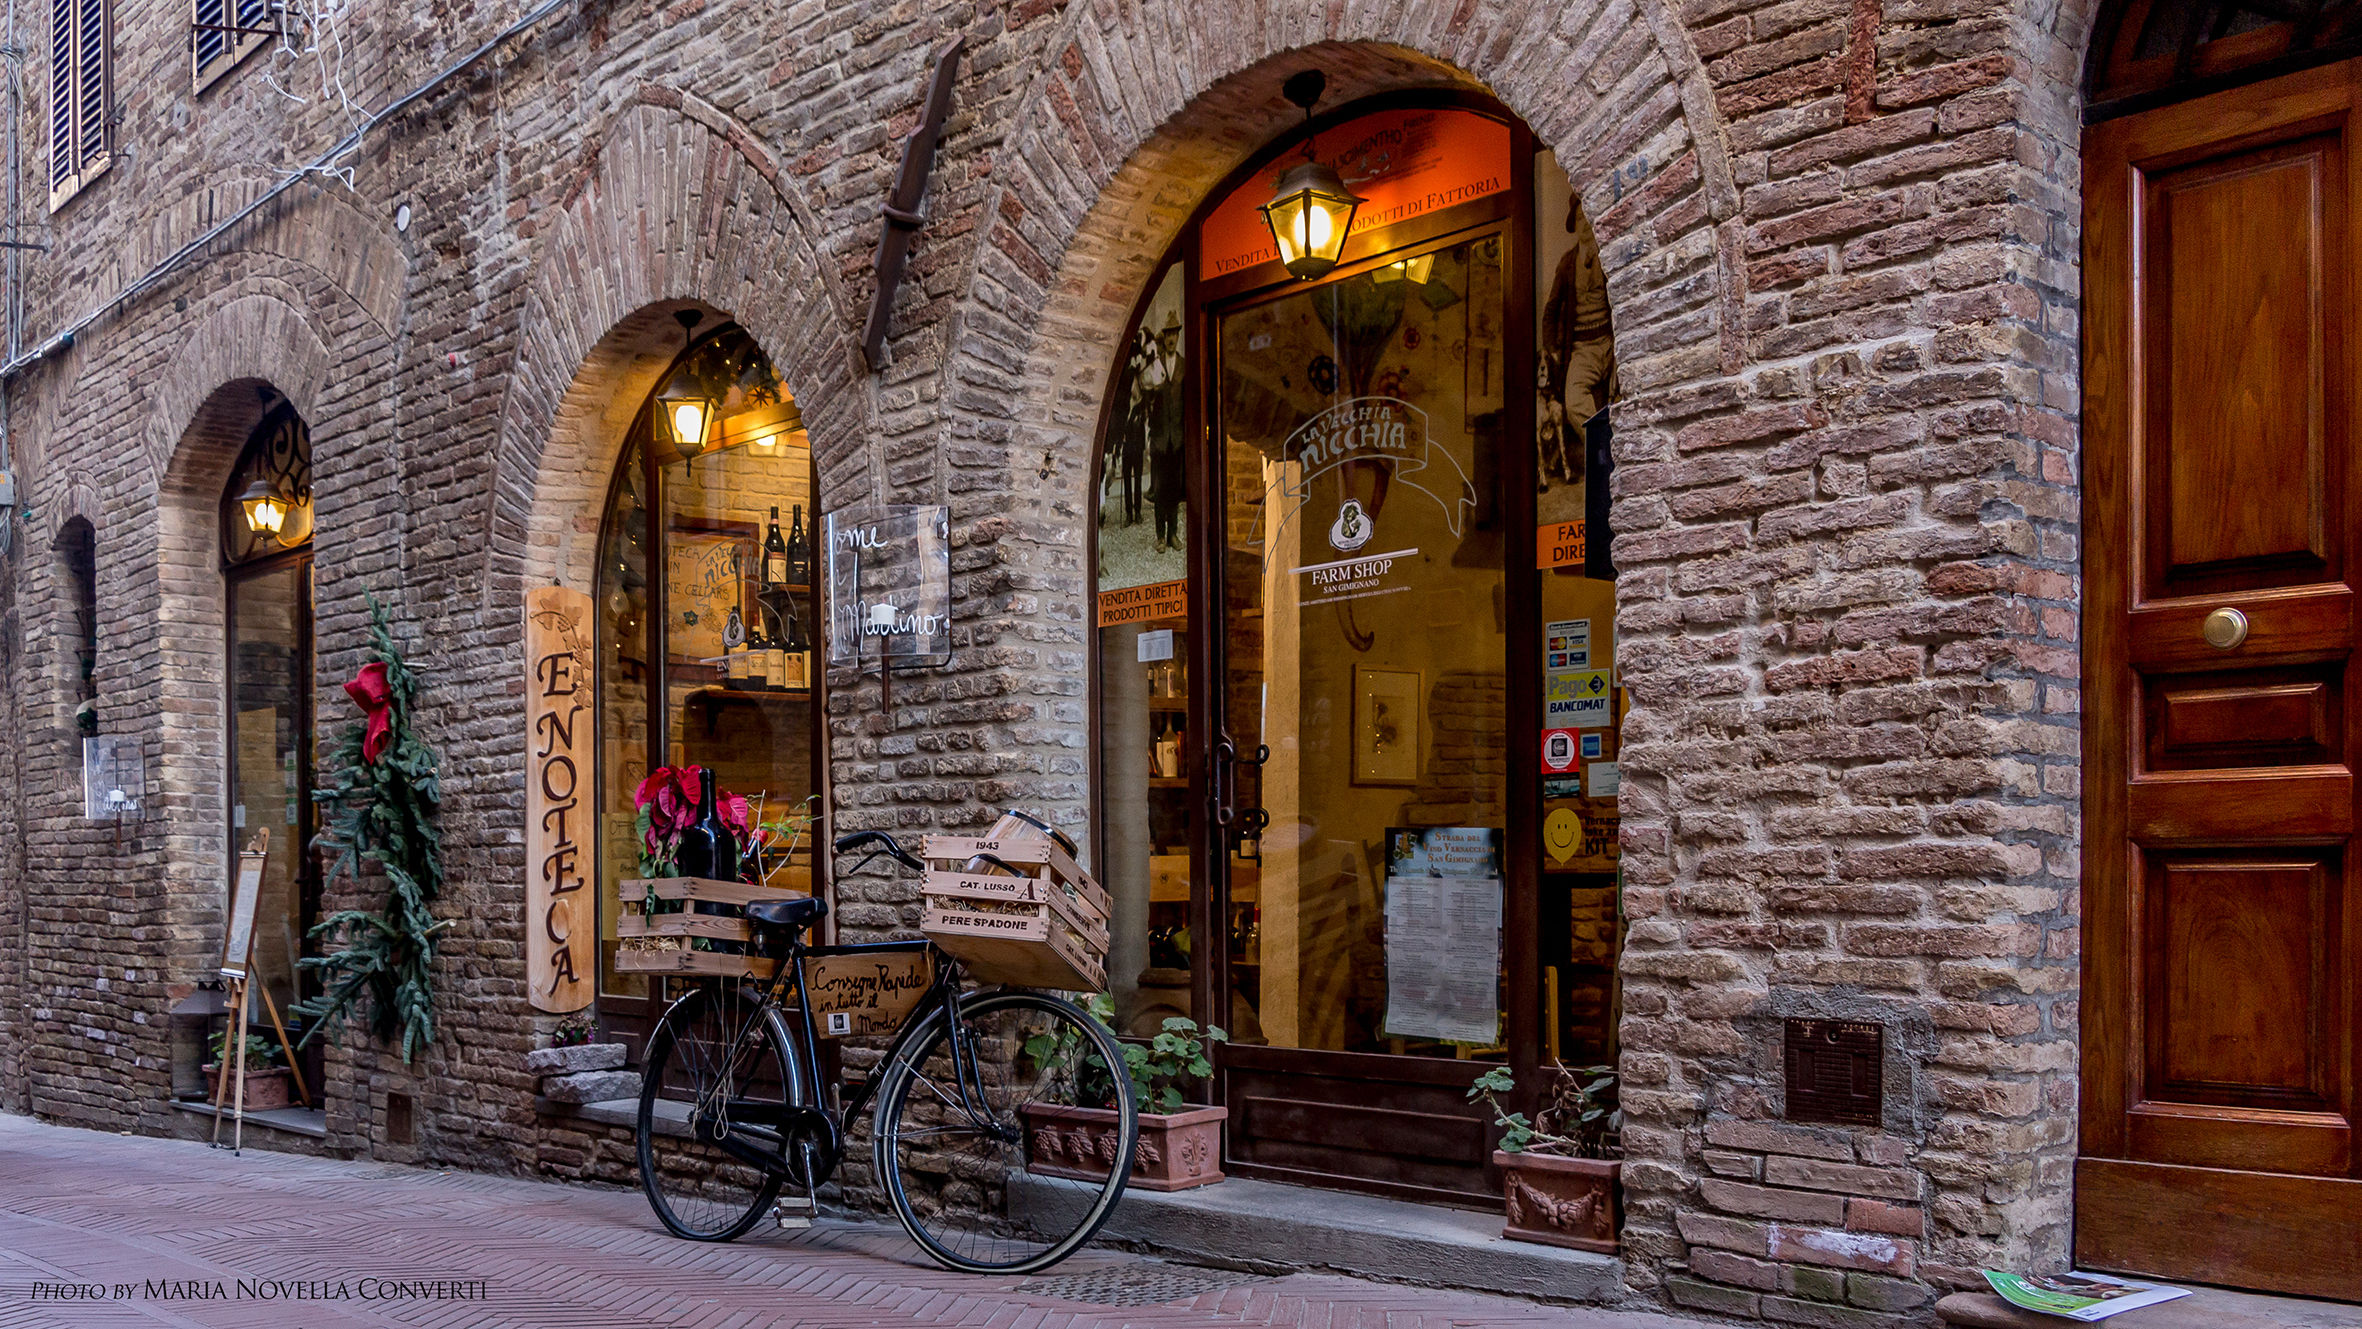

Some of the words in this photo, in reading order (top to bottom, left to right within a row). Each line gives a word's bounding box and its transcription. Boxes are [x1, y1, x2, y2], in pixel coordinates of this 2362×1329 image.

[1215, 248, 1268, 273] VENDITA
[1408, 201, 1423, 216] DI
[1425, 176, 1500, 210] FATTORIA
[1302, 426, 1320, 444] LA
[1558, 523, 1585, 542] FAR
[668, 545, 701, 560] TECA
[1553, 543, 1585, 562] DIRE
[1312, 566, 1352, 586] FARM
[1354, 559, 1393, 579] SHOP
[668, 581, 680, 594] NE
[685, 583, 730, 601] CELLARS
[1099, 590, 1142, 607] VENDITA
[1145, 583, 1189, 601] DIRETTA
[1323, 584, 1338, 594] SAN
[1338, 578, 1380, 592] GIMIGNANO
[1103, 604, 1152, 623] PRODOTTI
[1154, 599, 1183, 616] TIPICI
[1549, 676, 1588, 699] Pago
[1550, 698, 1606, 713] BANCOMAT
[536, 651, 585, 998] ENOTECA
[1584, 815, 1621, 826] Vernacc
[975, 841, 1000, 850] 1943
[1435, 831, 1465, 842] STRADA
[1585, 838, 1609, 855] KIT
[960, 880, 981, 890] CAT.
[984, 882, 1016, 892] LUSSO
[1017, 878, 1037, 901] A
[941, 915, 971, 927] PERE
[973, 917, 1028, 930] SPADONE
[811, 966, 877, 997] Consegne
[875, 964, 923, 1000] Rapide
[819, 999, 834, 1013] in
[836, 992, 865, 1010] tutto
[866, 992, 879, 1009] il
[858, 1011, 898, 1033] Mondo
